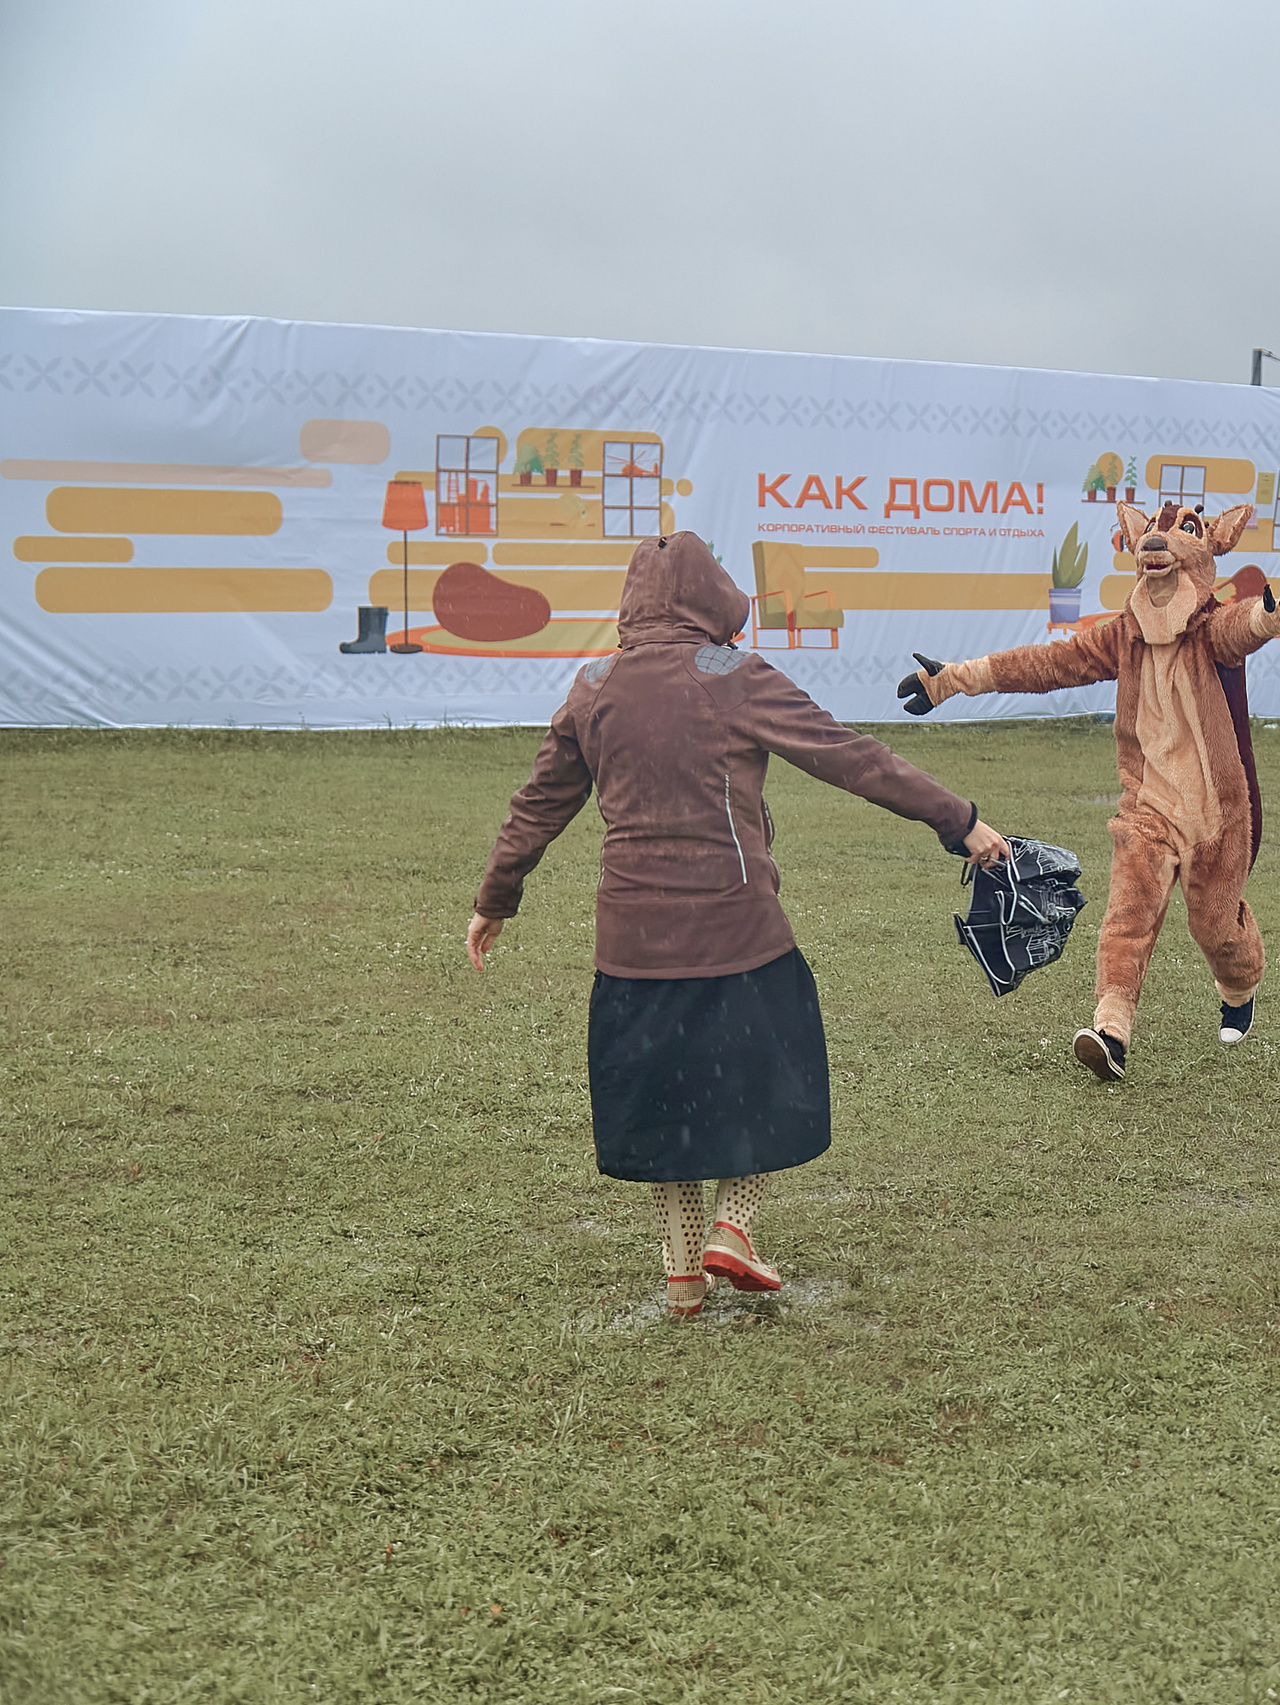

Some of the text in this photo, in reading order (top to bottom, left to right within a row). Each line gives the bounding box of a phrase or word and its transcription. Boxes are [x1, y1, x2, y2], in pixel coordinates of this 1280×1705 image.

[758, 472, 1044, 519] КАК ДОМА!
[758, 523, 1045, 539] КОРПОРАТИВНЫЙ ФЕСТИВАЛЬ СПОРТА И ОТДЫХА
